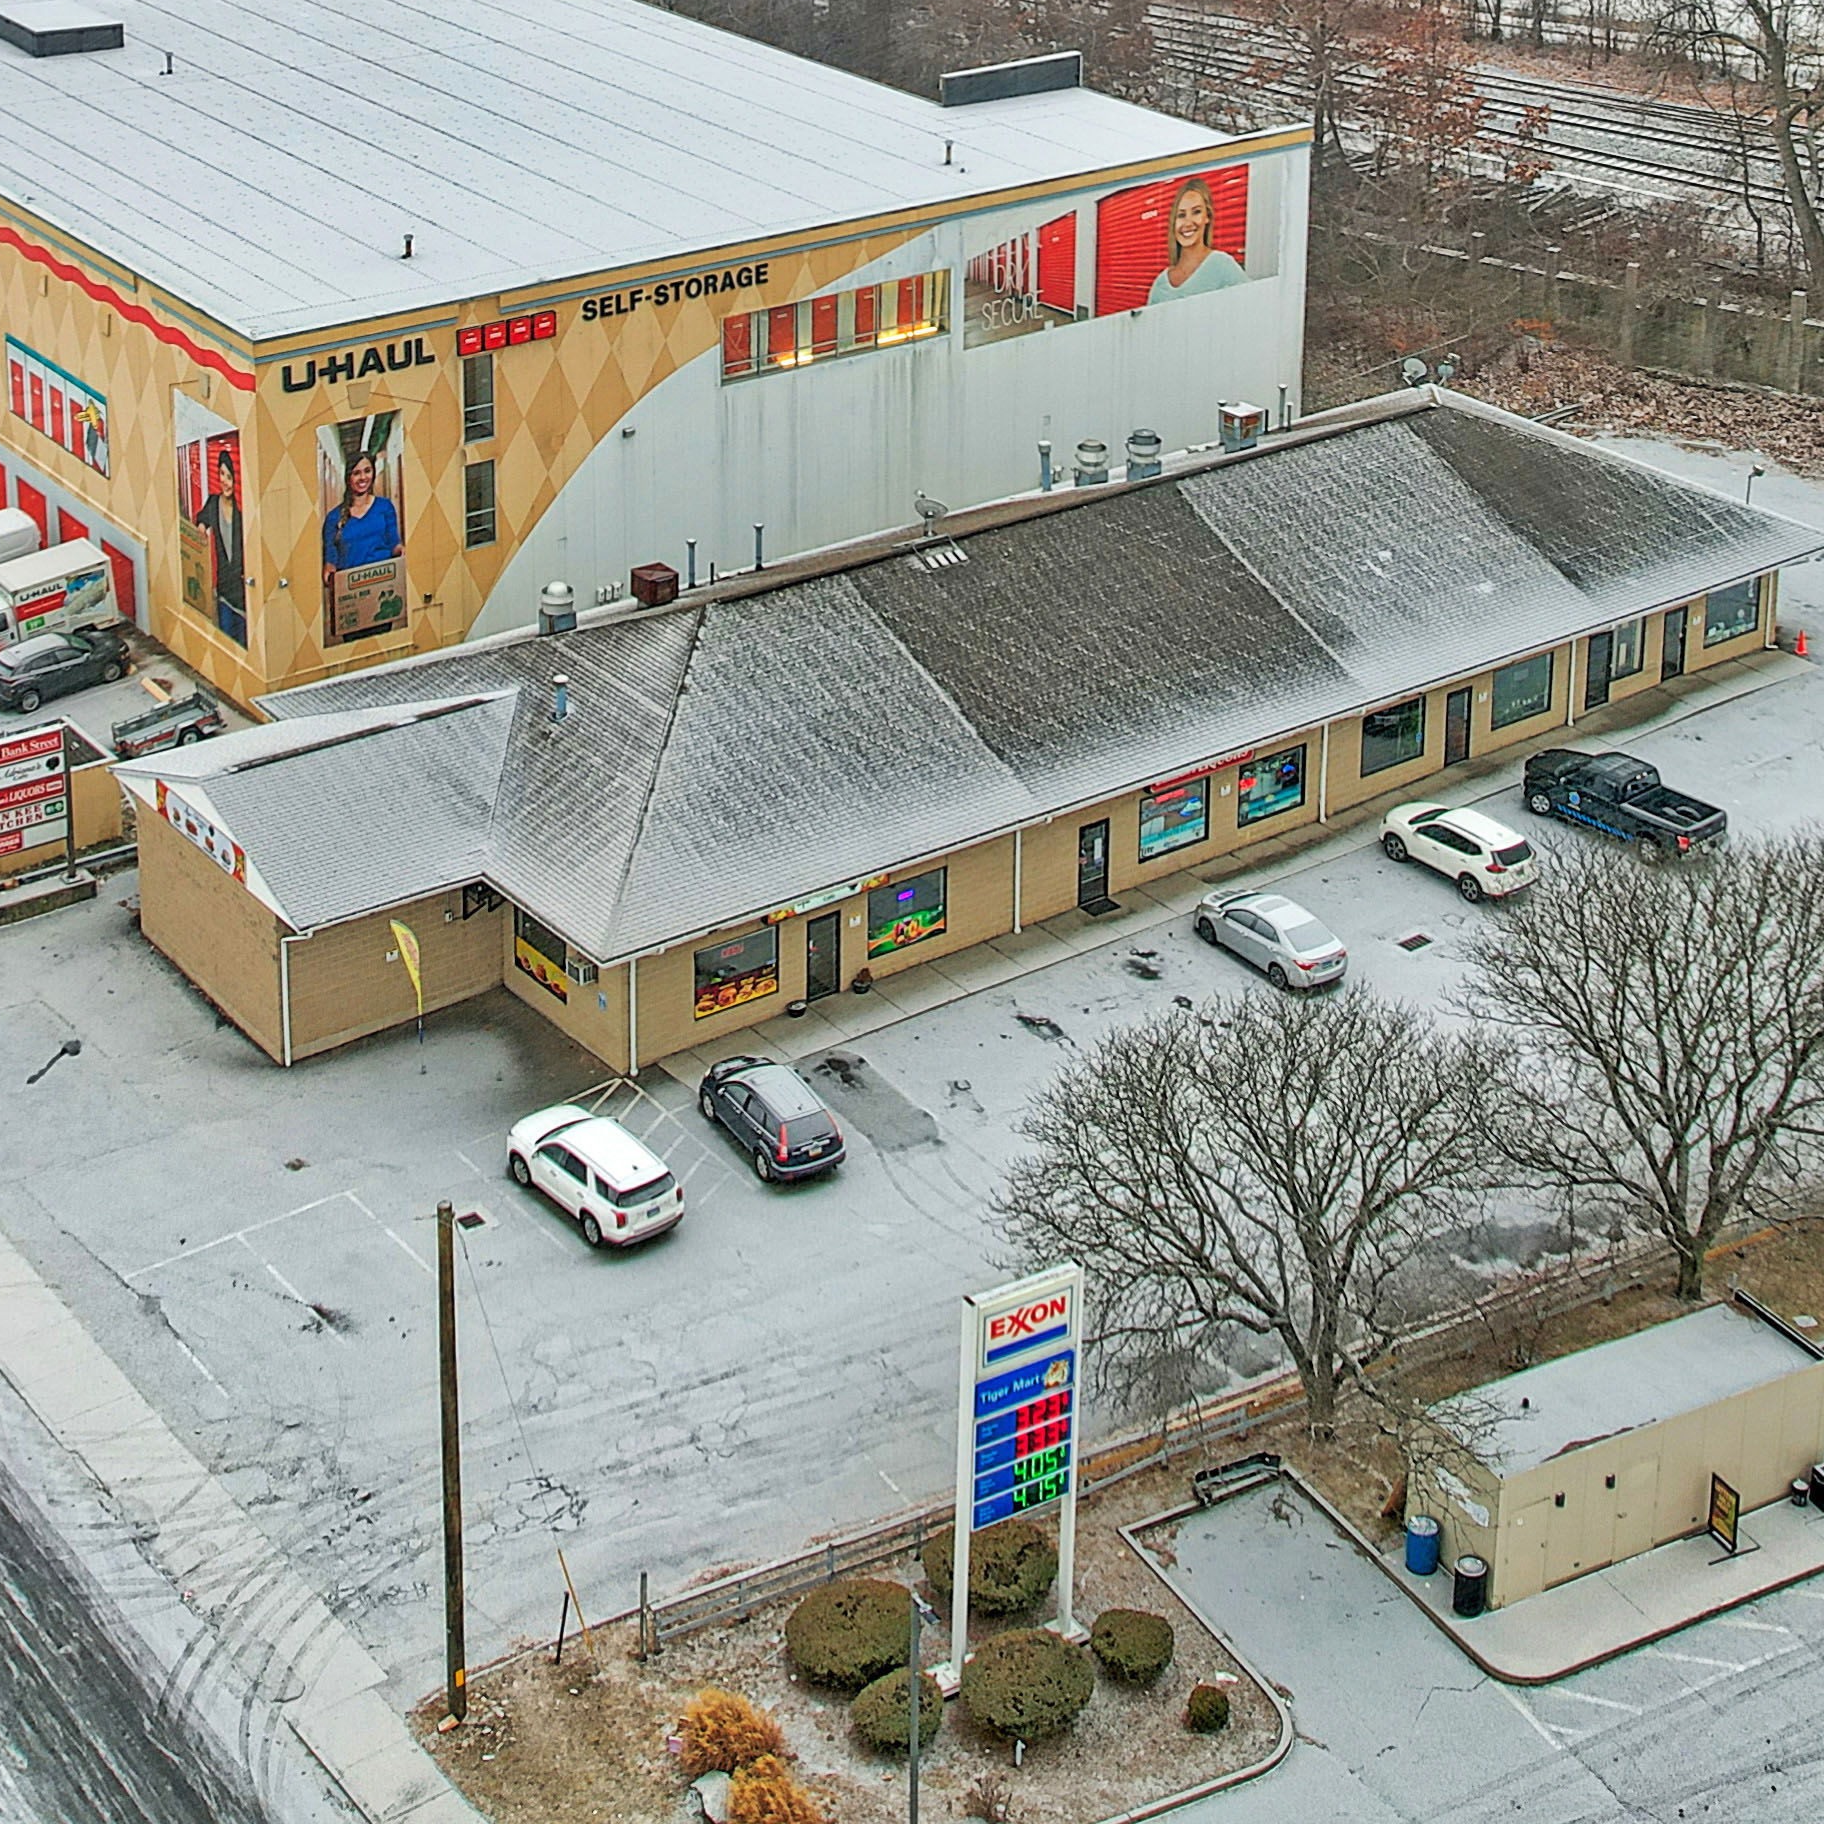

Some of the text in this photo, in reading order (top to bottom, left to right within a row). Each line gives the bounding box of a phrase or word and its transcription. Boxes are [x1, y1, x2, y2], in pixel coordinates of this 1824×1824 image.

[581, 263, 769, 322] SELF-STORAGE
[981, 290, 1044, 332] SECURE
[282, 337, 436, 393] U-HAUL
[351, 565, 393, 583] U-HAUL
[19, 583, 64, 602] U-HAUL
[1, 742, 28, 759] Bank
[29, 736, 59, 751] Street
[9, 782, 46, 802] LIQUORS
[15, 803, 43, 818] KEE
[991, 1295, 1066, 1341] EXXON
[980, 1373, 1041, 1405] Tiger Mart
